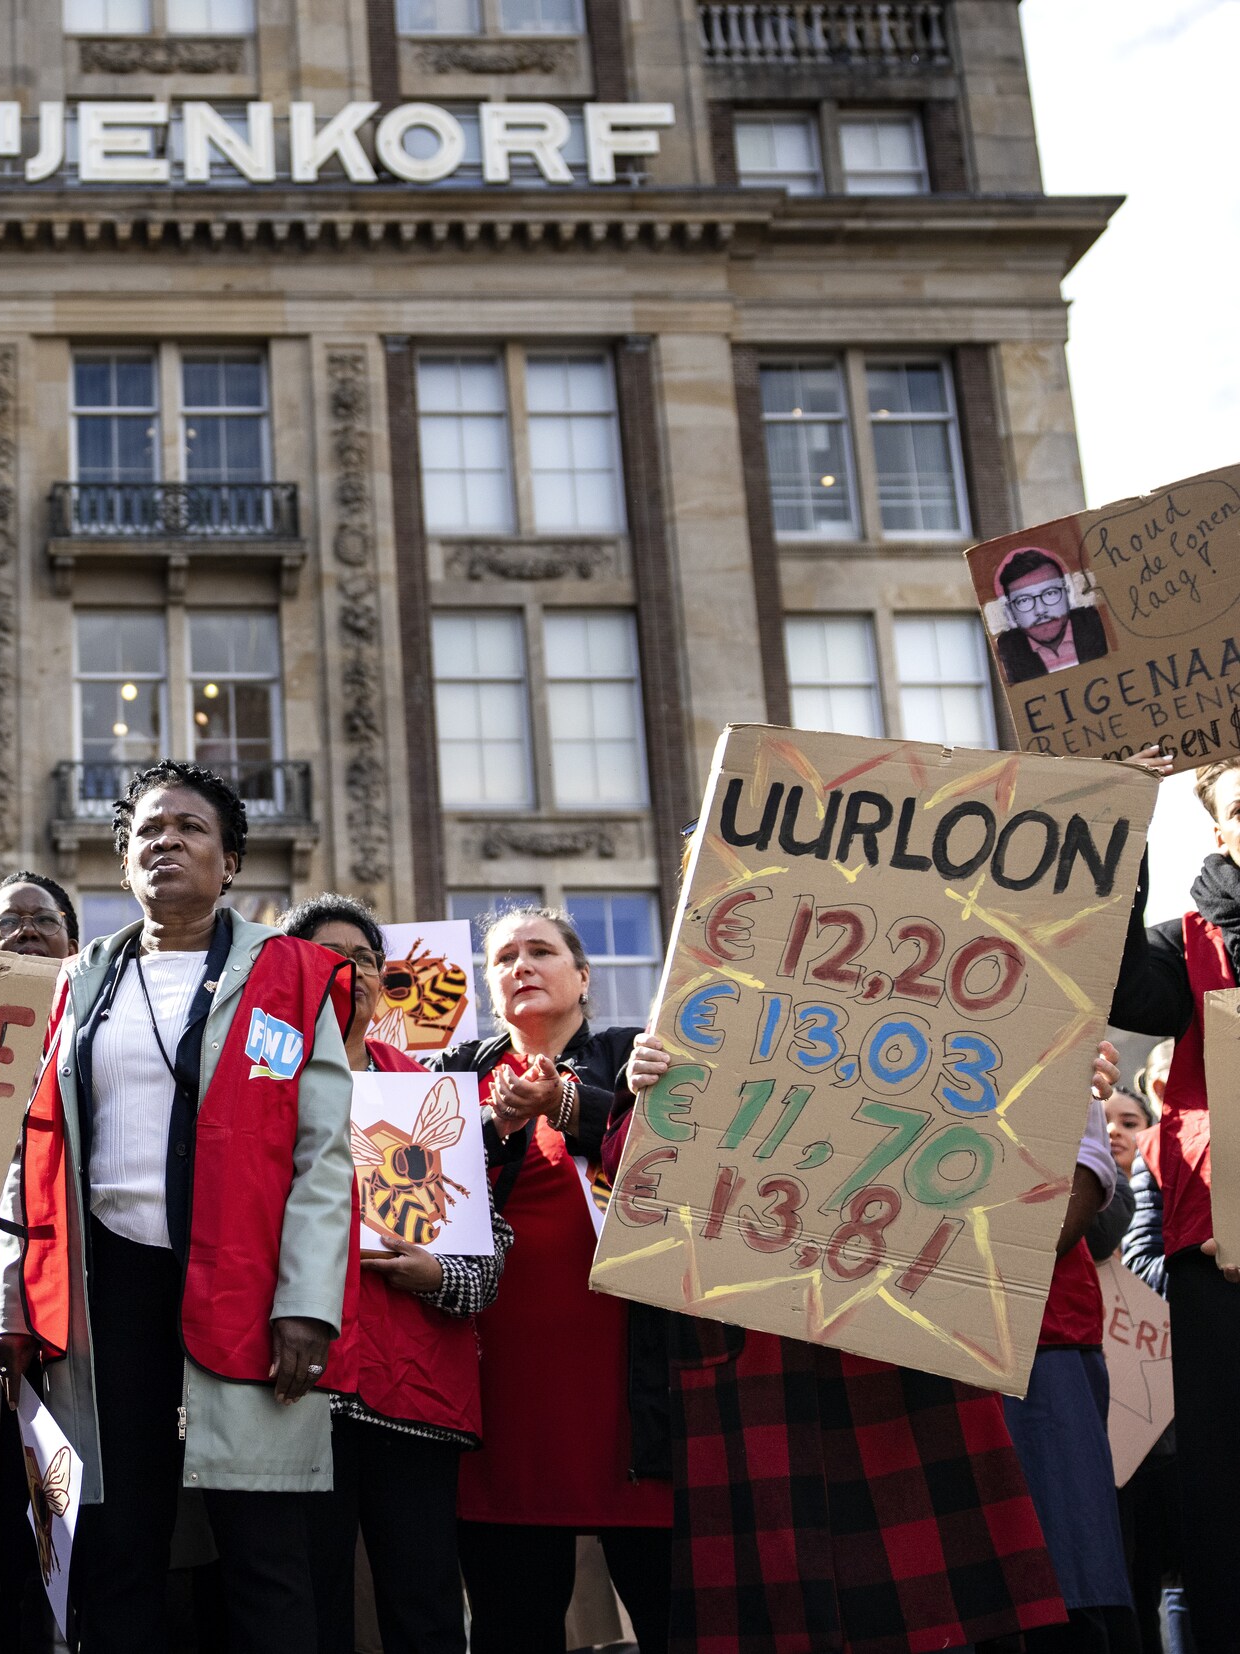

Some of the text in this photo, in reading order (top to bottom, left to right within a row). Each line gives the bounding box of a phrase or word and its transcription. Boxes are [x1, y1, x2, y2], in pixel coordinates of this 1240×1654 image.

[1094, 495, 1190, 568] houd
[1140, 553, 1167, 585] de
[720, 778, 1129, 897] UURLOON
[776, 894, 1027, 1021] 12,20
[250, 1019, 304, 1064] FNV
[750, 992, 1003, 1118] 13,03
[717, 1079, 1005, 1217] 11,70
[699, 1165, 964, 1298] 13,81
